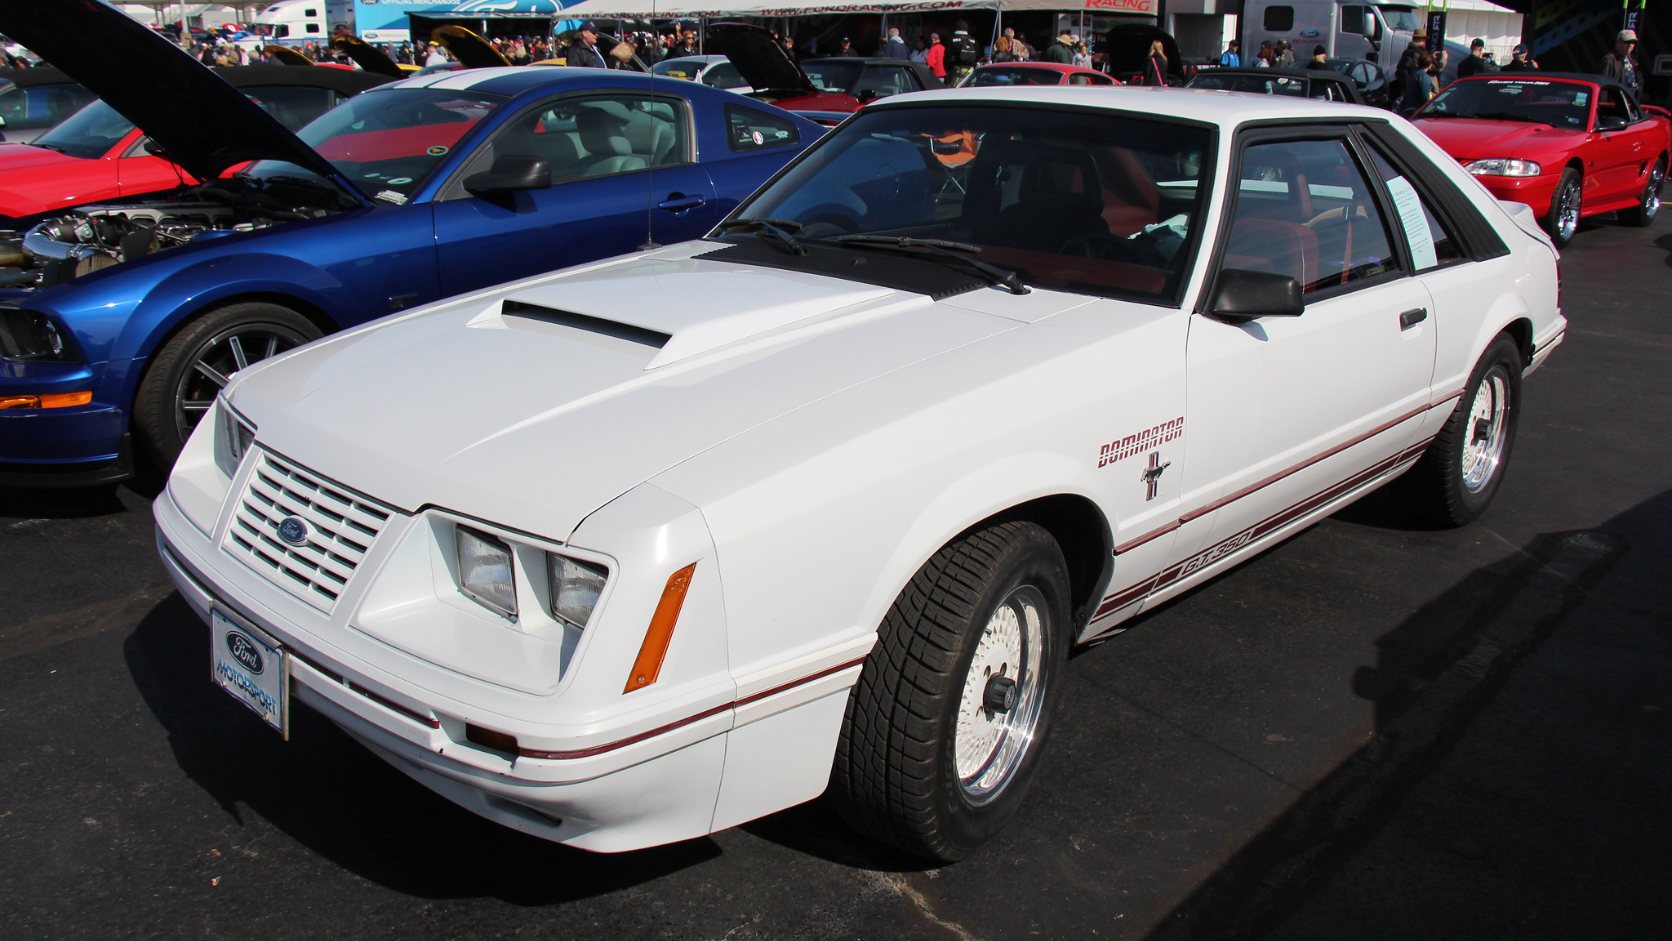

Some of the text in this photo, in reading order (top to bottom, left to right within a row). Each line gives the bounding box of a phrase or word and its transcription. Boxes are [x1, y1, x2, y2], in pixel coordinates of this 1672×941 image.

[1097, 416, 1184, 469] DOMINATOR
[233, 636, 257, 669] Ford
[217, 659, 277, 716] MOTORSPORT
